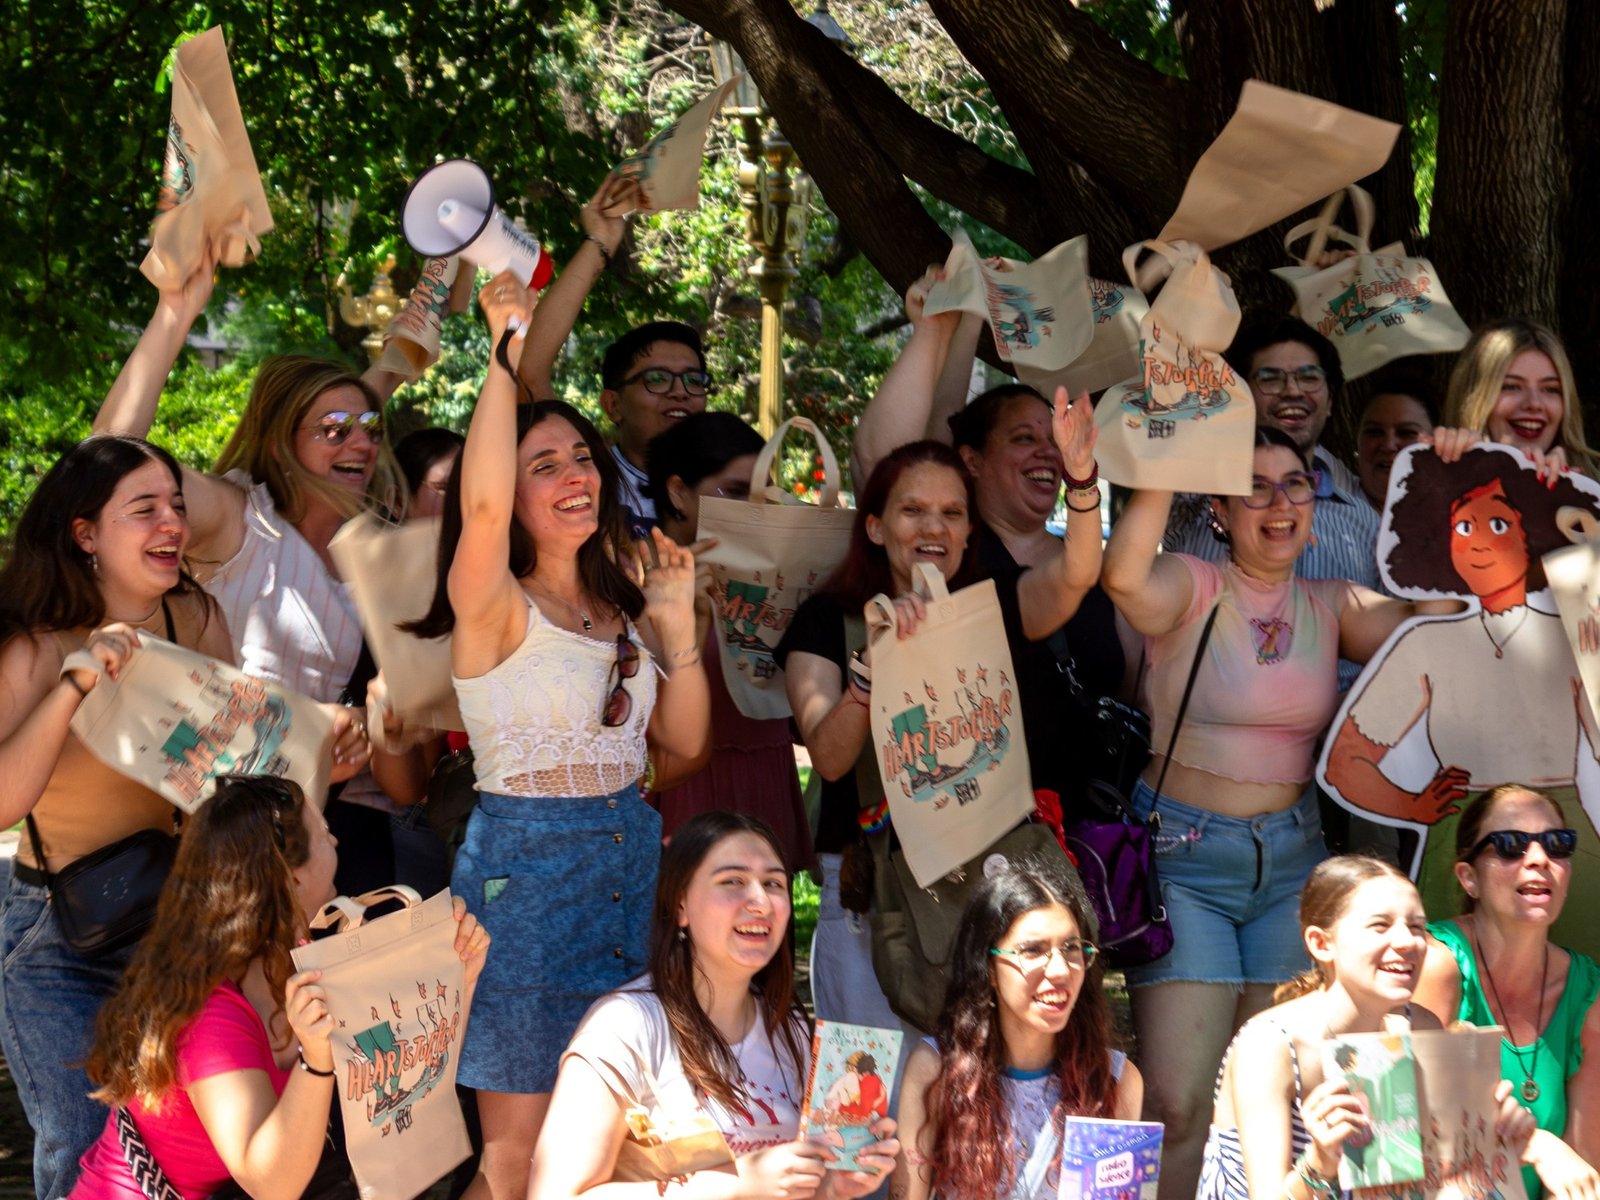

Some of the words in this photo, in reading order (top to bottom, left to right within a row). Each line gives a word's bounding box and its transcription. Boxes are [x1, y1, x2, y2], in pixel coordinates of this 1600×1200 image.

[1141, 357, 1236, 393] TSTOPPER
[883, 688, 1012, 783] HEARTSTOPPER
[347, 1011, 459, 1102] HEARTSTOPPER
[1093, 1144, 1116, 1160] alice
